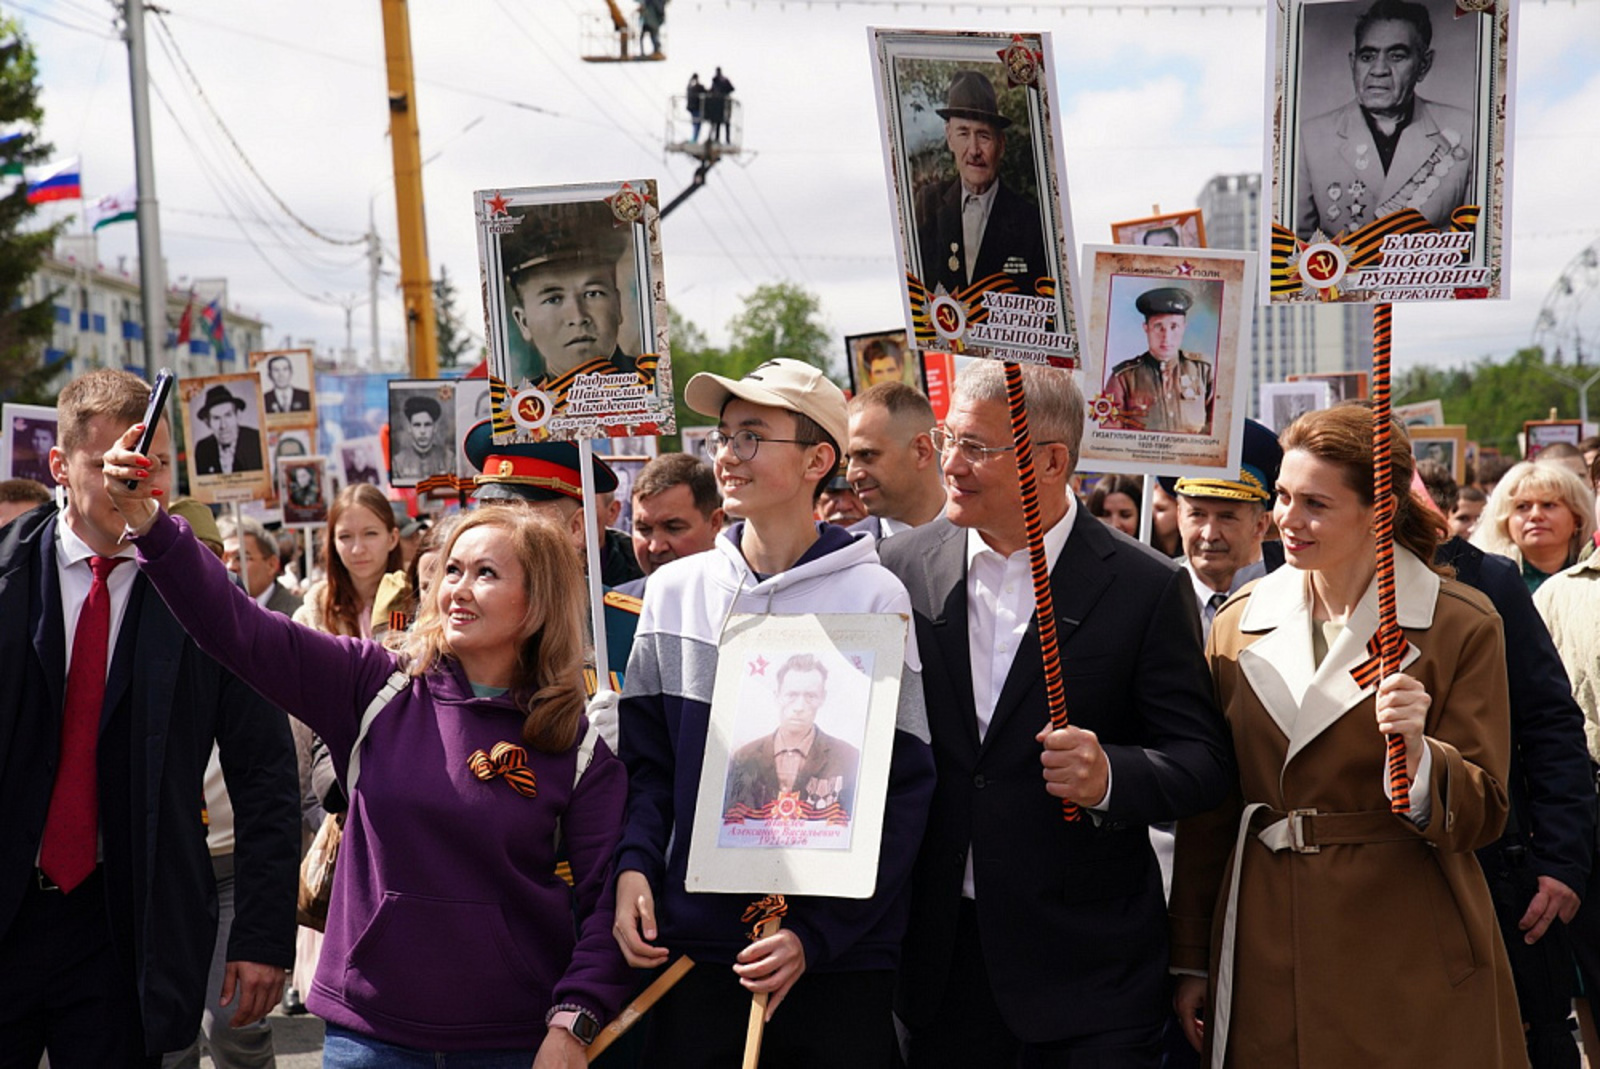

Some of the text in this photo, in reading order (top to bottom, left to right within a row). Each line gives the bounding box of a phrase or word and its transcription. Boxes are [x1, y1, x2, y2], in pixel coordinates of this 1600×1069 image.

[1382, 233, 1471, 250] БАБОЯН
[1381, 251, 1462, 268] ИОСИФ
[1358, 268, 1487, 287] РУБЕНОВИЧ
[1380, 288, 1450, 300] СЕРЖАНТ
[983, 293, 1057, 314] ХАБИРОВ
[989, 311, 1045, 329] БАРЫЙ
[970, 326, 1072, 349] ЛАТЫПОВИЧ
[994, 349, 1047, 362] РЯДОВОЙ
[575, 373, 638, 388] Бадранов
[567, 387, 647, 400] Шайхислам
[569, 400, 647, 413] Магадеевич
[1138, 433, 1160, 442] ЗАГИТ
[728, 826, 841, 838] Александр Васильевич
